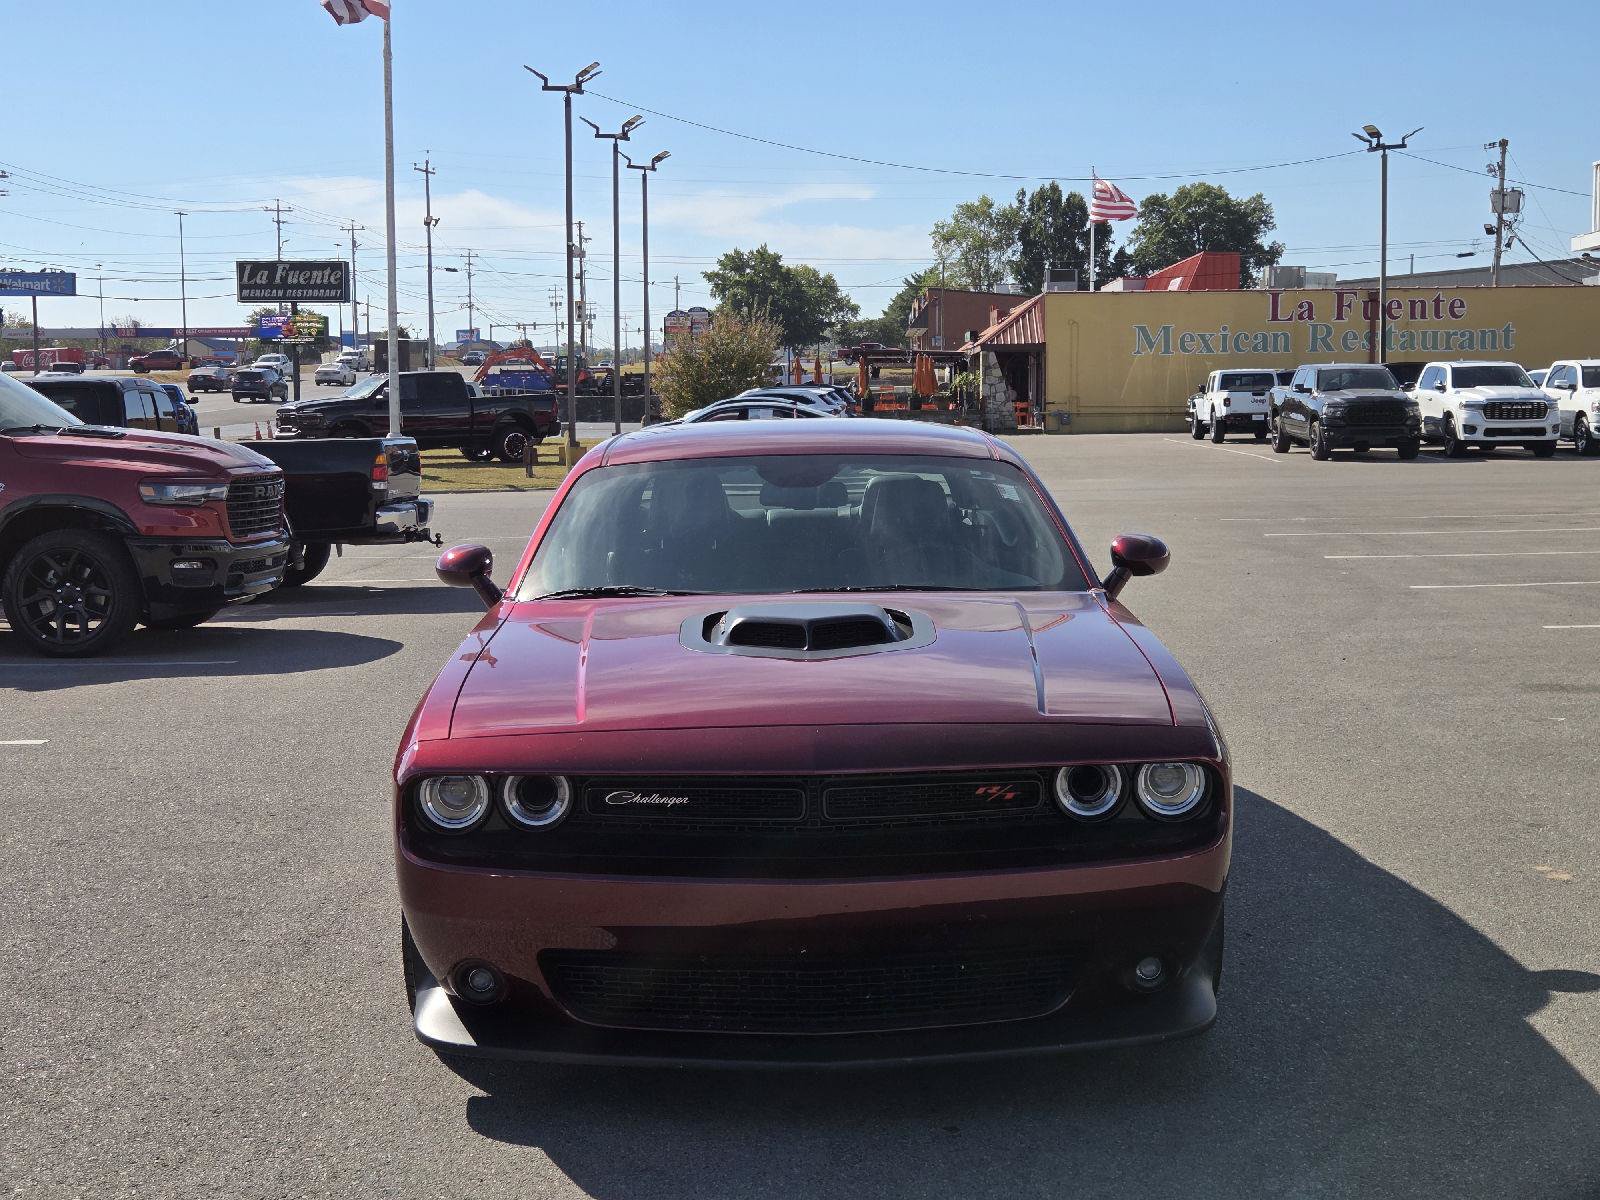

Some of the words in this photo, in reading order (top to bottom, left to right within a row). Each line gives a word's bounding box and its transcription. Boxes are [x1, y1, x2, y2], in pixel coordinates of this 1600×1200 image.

[241, 263, 269, 285] La
[273, 263, 342, 285] Fuente
[241, 289, 284, 298] MEXICAN
[286, 289, 342, 298] RESTAURANT
[1266, 291, 1317, 323] La
[1333, 290, 1468, 323] Fuente
[1131, 324, 1292, 356] Mexican
[1306, 321, 1517, 354] Restaurant
[605, 790, 690, 808] Challenger
[975, 784, 1021, 802] R/T
